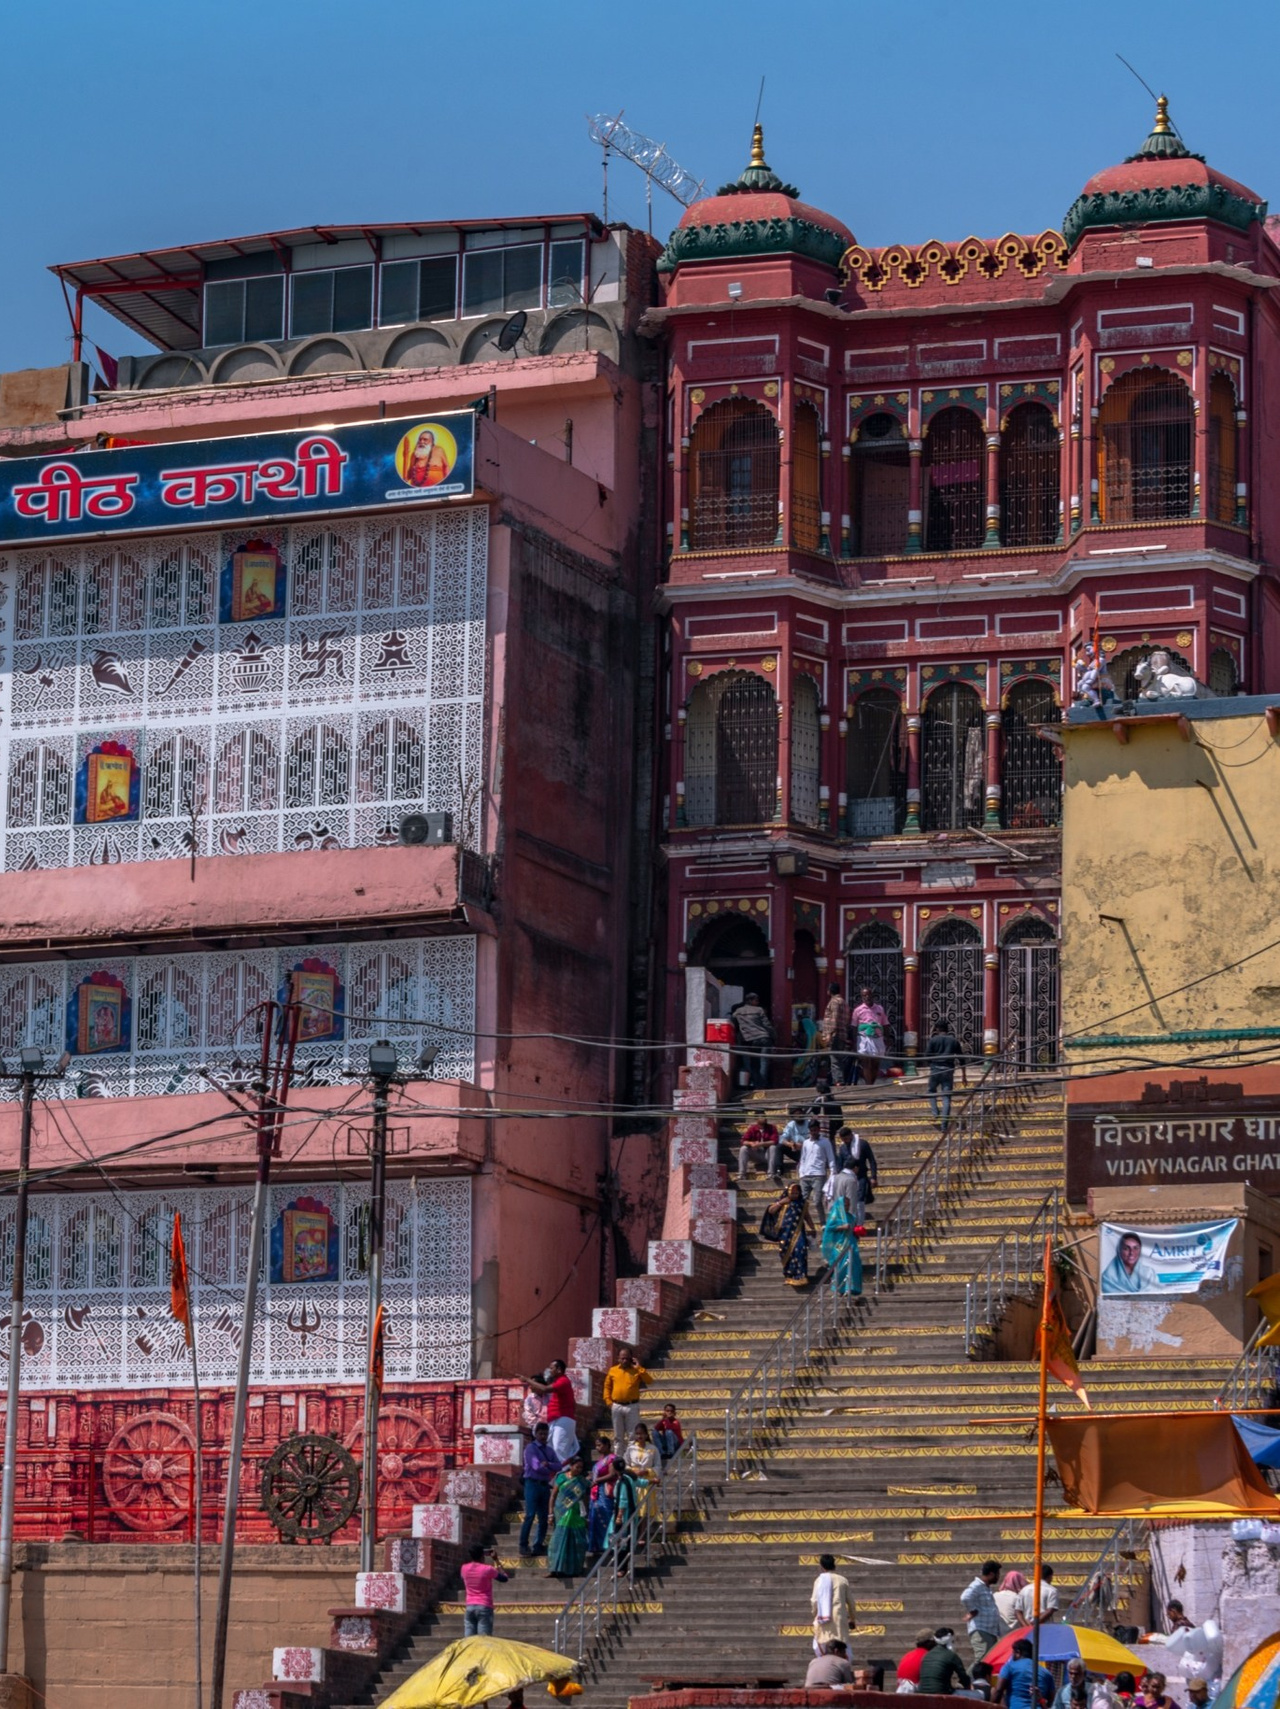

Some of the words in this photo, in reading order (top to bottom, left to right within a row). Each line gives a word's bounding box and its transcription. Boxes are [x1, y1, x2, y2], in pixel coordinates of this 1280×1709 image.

[13, 461, 139, 522] पीठ
[161, 436, 348, 507] काशी
[1093, 1115, 1235, 1146] विजयनगर
[1244, 1117, 1280, 1140] घा
[1106, 1156, 1228, 1176] VIJAYNAGAR
[1233, 1154, 1280, 1171] GHAT
[1149, 1242, 1198, 1258] AMRIT
